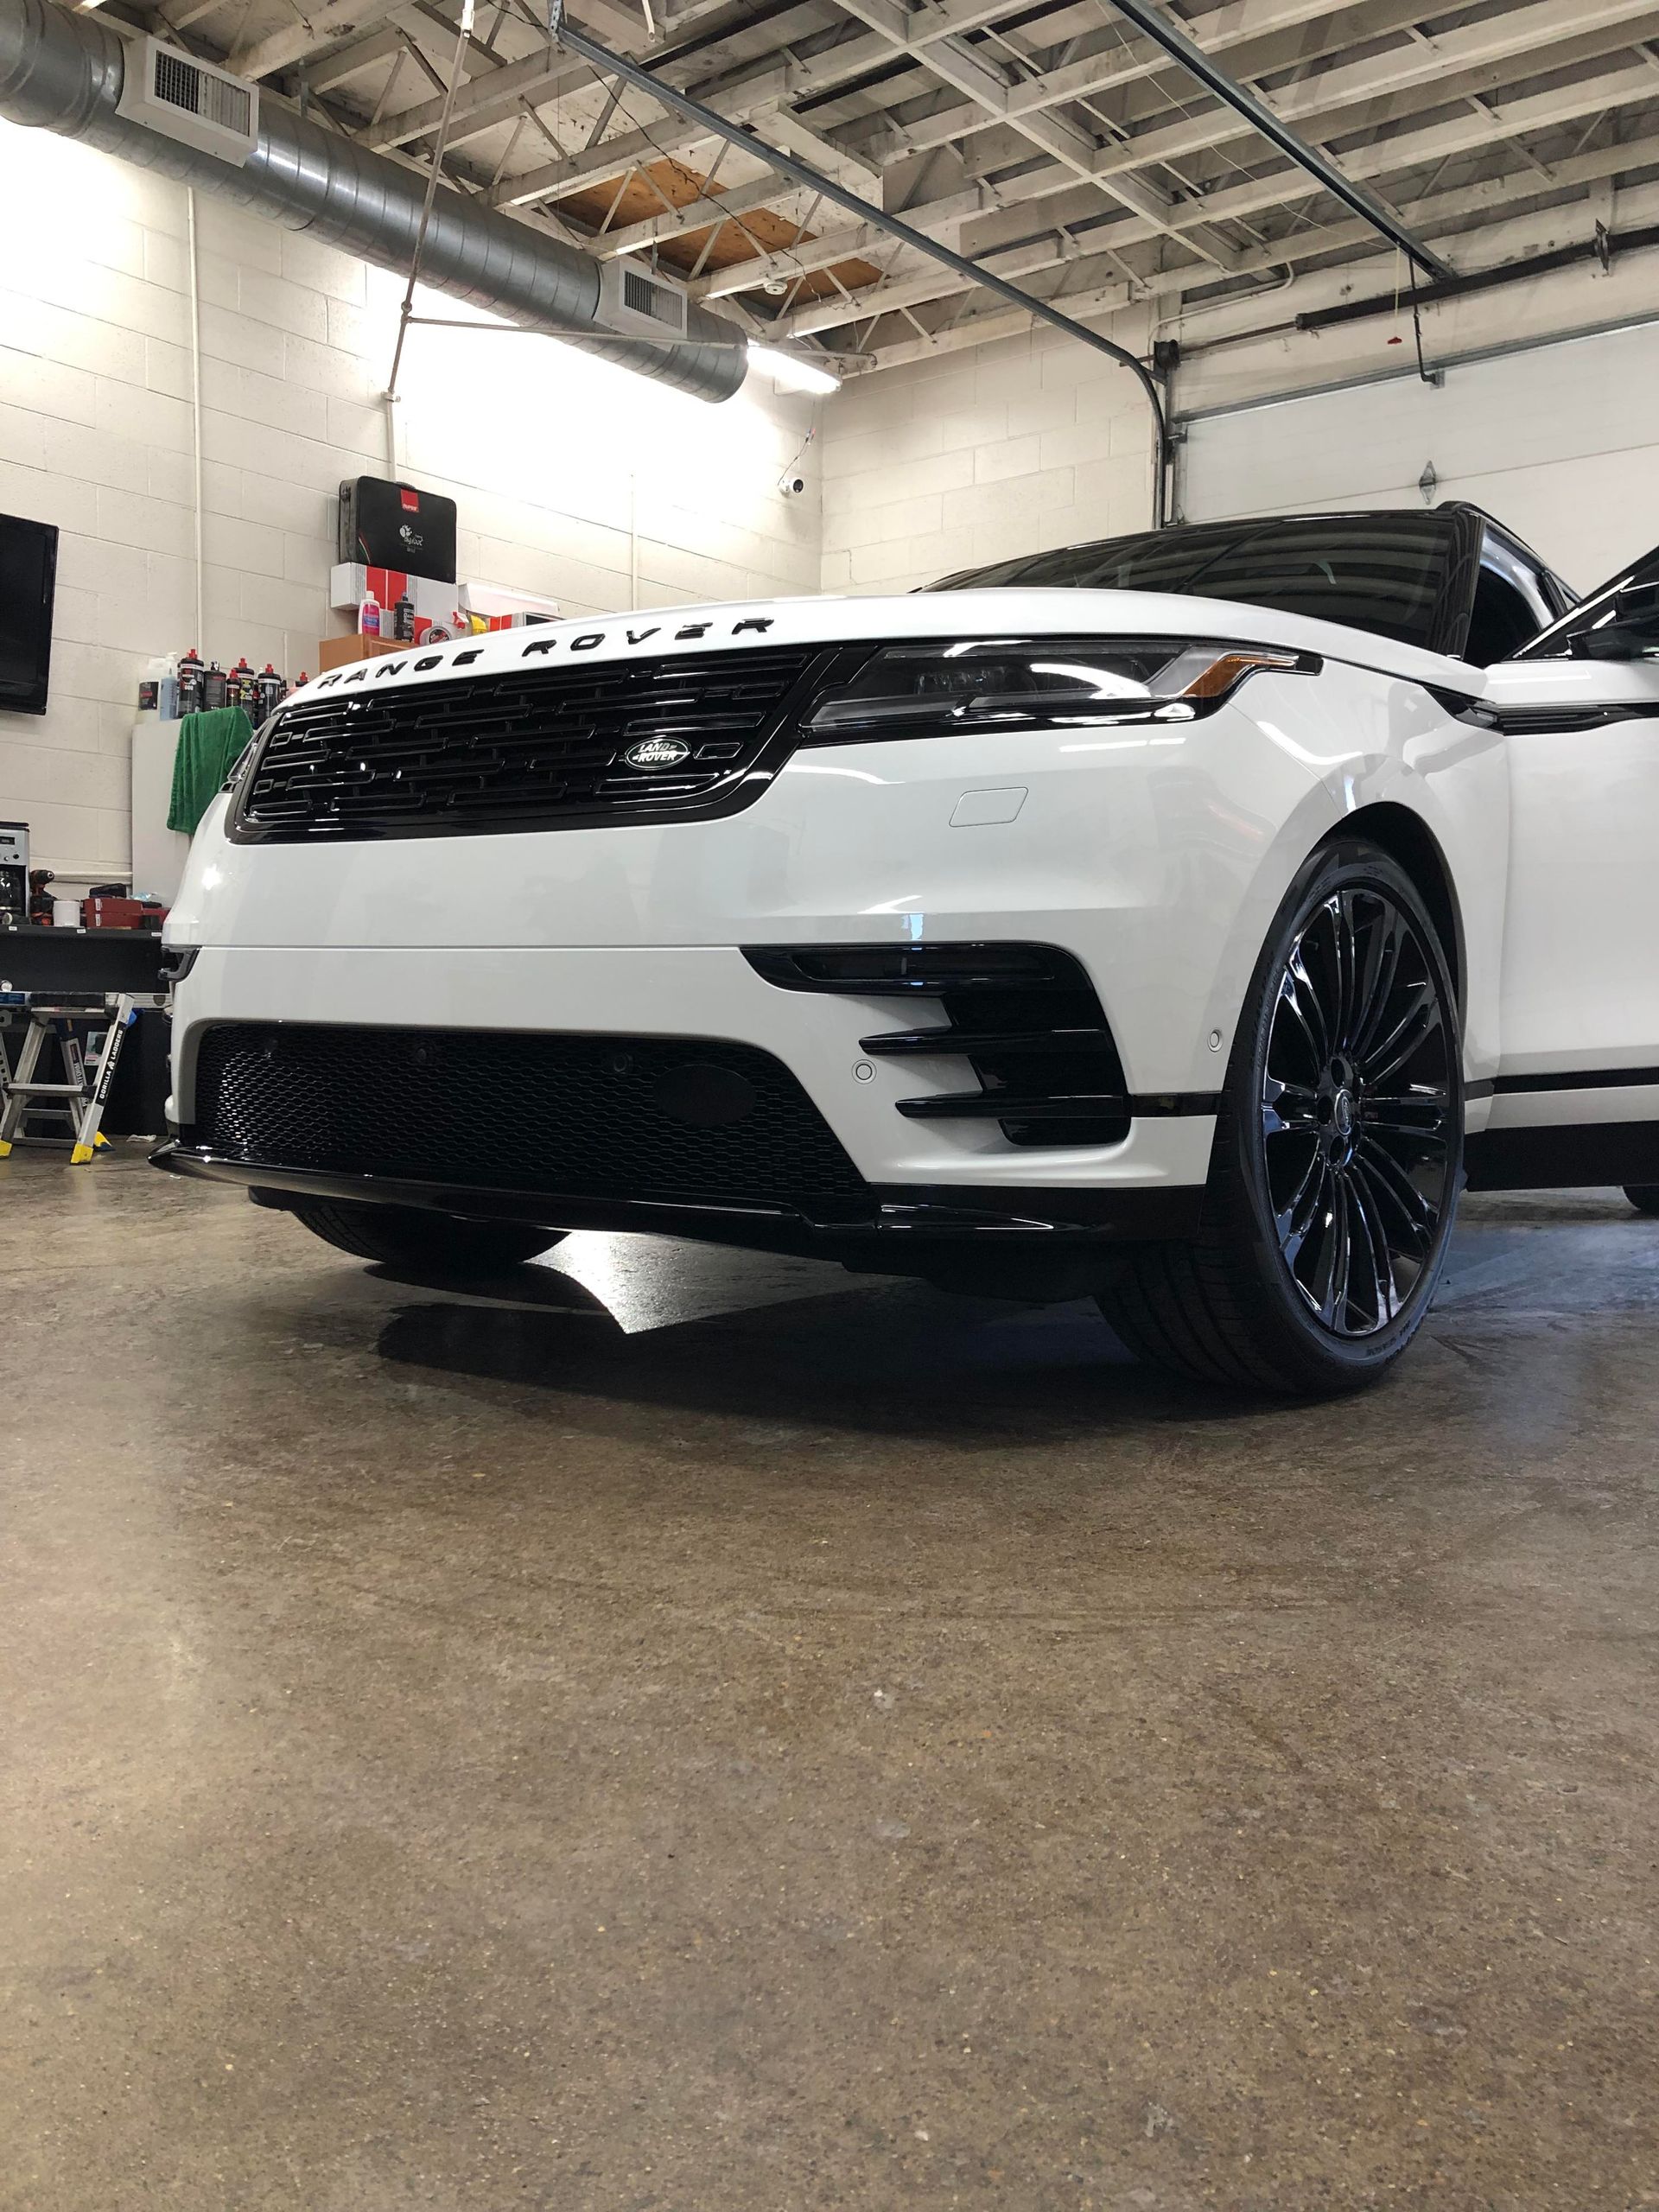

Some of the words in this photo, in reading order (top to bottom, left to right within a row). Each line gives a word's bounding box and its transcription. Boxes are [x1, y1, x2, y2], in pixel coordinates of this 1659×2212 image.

[317, 649, 485, 689] RANGE
[522, 618, 774, 657] ROVER
[638, 743, 671, 753] LAND
[638, 751, 676, 762] ROVER
[99, 1071, 111, 1099] GORILLA
[111, 1029, 124, 1060] LADDERS
